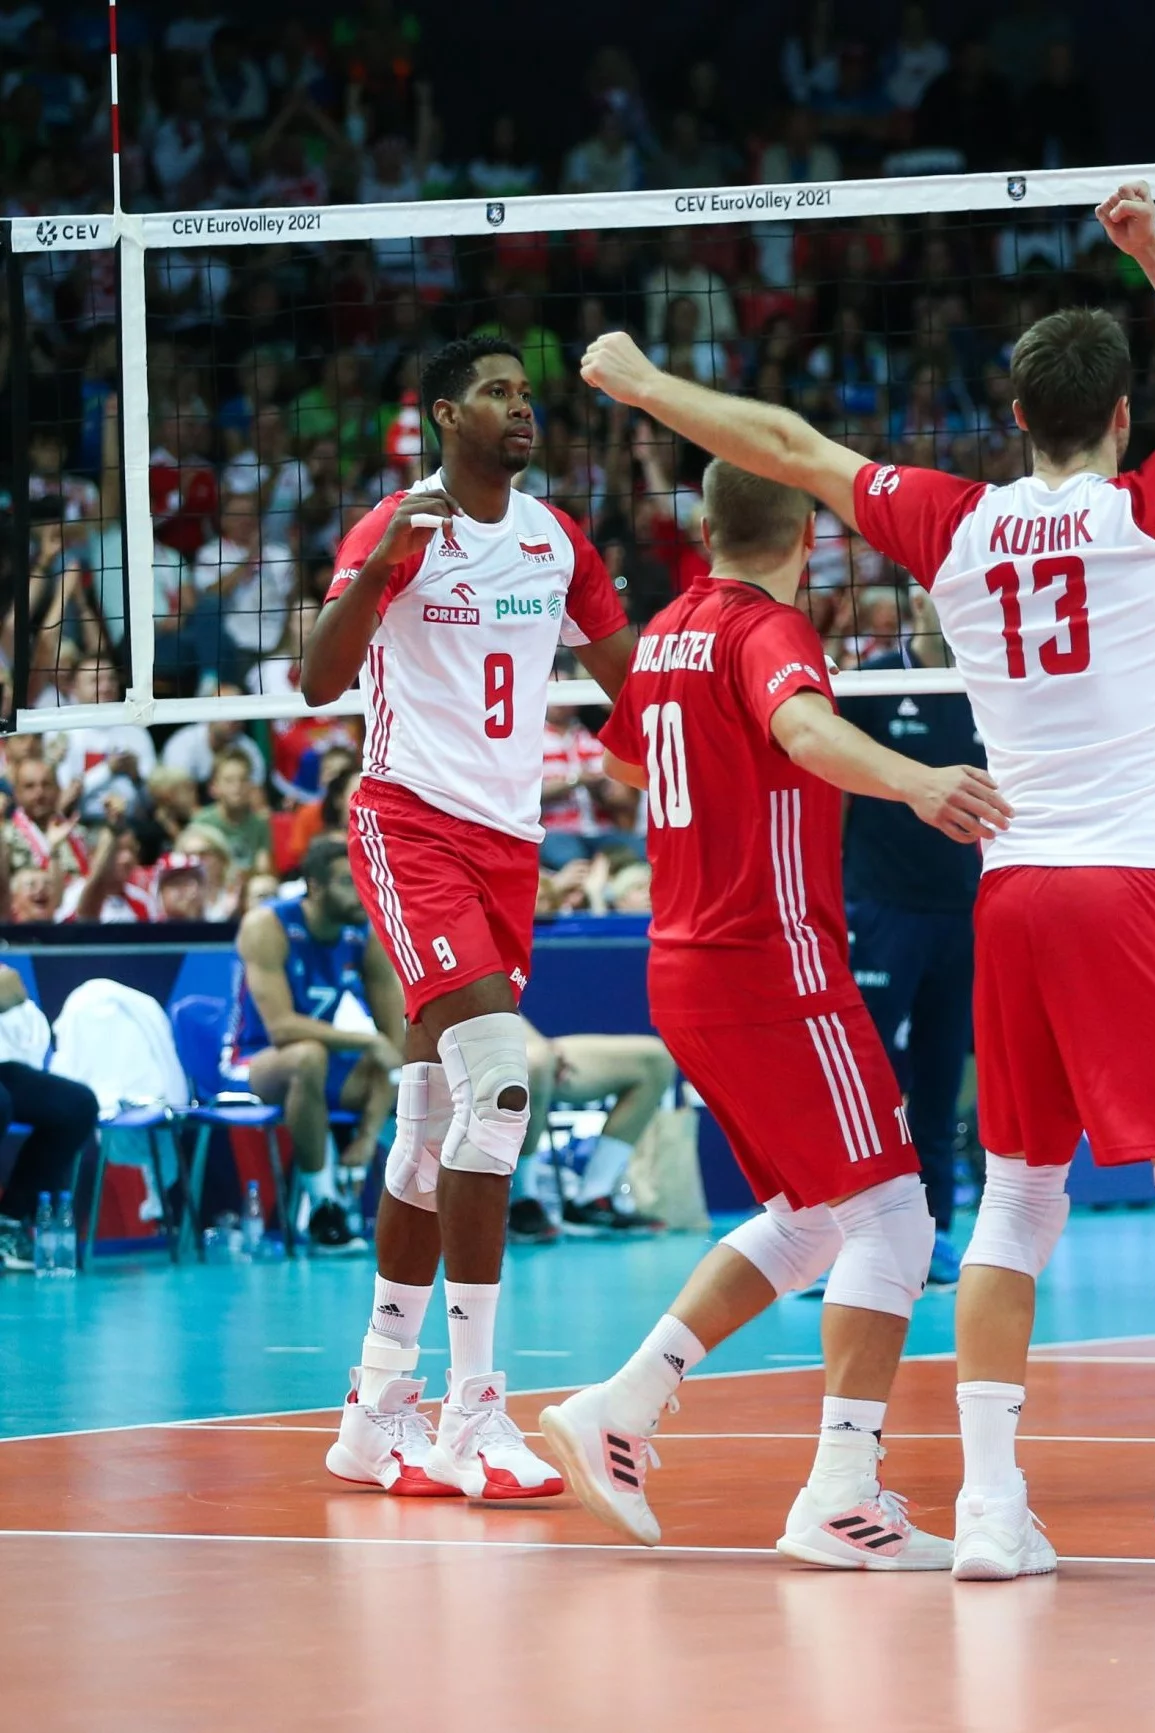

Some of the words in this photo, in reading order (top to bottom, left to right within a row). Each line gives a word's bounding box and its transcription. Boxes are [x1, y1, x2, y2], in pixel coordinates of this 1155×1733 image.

[675, 196, 707, 214] CEV
[710, 191, 793, 213] EuroVolley
[796, 190, 831, 207] 2021
[62, 224, 100, 241] CEV
[172, 219, 203, 235] CEV
[207, 216, 285, 236] EuroVolley
[288, 214, 321, 231] 2021
[988, 508, 1094, 556] KUBIAK
[438, 549, 469, 560] adidas
[425, 607, 478, 624] ORLEN
[496, 594, 543, 620] plus
[984, 555, 1091, 679] 13
[766, 662, 802, 694] plus
[483, 652, 514, 739] 9
[641, 701, 692, 829] 10
[431, 935, 458, 971] 9
[307, 986, 338, 1020] 7
